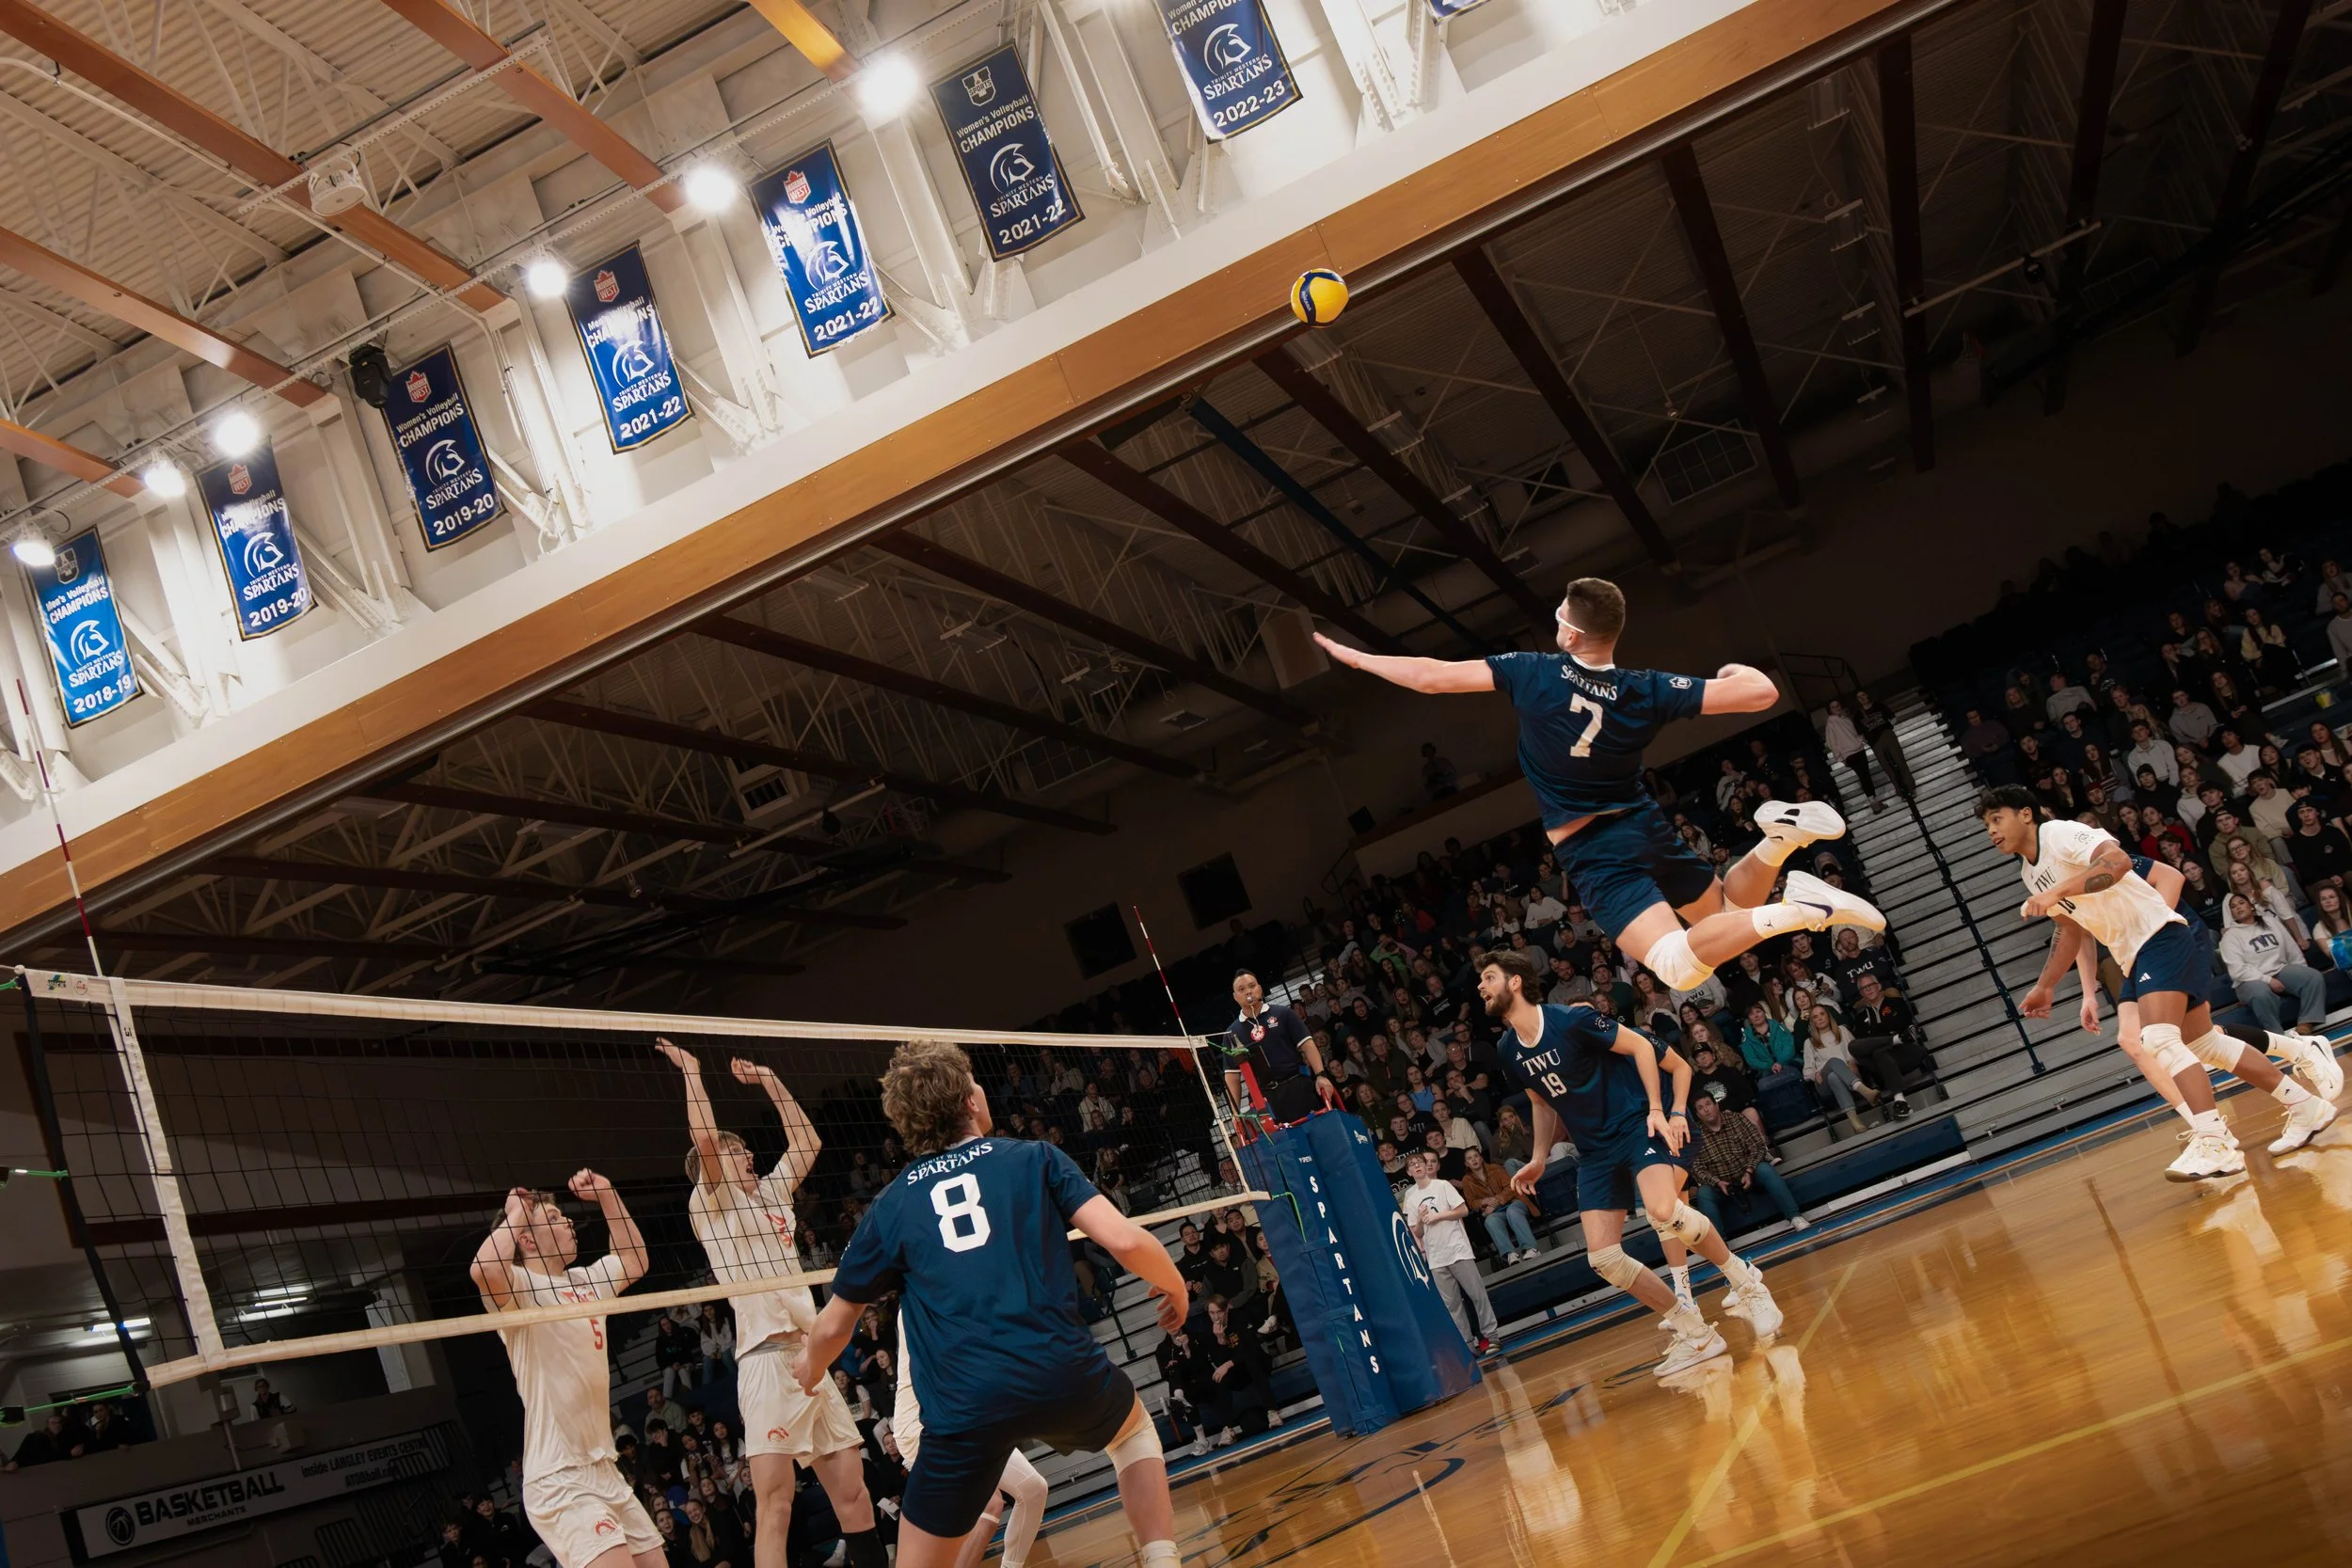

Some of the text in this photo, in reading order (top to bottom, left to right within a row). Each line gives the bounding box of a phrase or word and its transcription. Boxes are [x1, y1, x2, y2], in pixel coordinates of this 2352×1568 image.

[968, 78, 993, 97] SPORTS
[1203, 53, 1273, 101] SPARTANS
[1212, 56, 1261, 85] TRINITY WESTERN
[957, 94, 1029, 138] Women's Volleyball
[1213, 80, 1286, 128] 2022-23
[961, 105, 1034, 153] CHAMPIONS
[789, 184, 809, 201] WEST
[990, 173, 1055, 218] SPARTANS
[999, 198, 1067, 245] 2021-22
[599, 285, 618, 300] WEST
[804, 271, 870, 314] SPARTANS
[811, 284, 831, 298] TRINITY
[814, 295, 881, 341] 2021-22
[411, 387, 430, 401] WEST
[612, 370, 672, 413] SPARTANS
[396, 392, 459, 434] Women's Volleyball
[399, 403, 464, 449] CHAMPIONS
[619, 396, 682, 439] 2021-22
[426, 467, 484, 510] SPARTANS
[433, 493, 495, 536] 2019-20
[46, 576, 104, 611] Men's Volleyball
[243, 562, 300, 602] SPARTANS
[50, 587, 109, 626] CHAMPIONS
[249, 586, 308, 627] 2019-20
[69, 650, 124, 689] SPARTANS
[73, 674, 132, 714] 2018-19
[1569, 692, 1603, 758] 7
[2034, 866, 2057, 893] TWU
[2249, 933, 2280, 952] TWU
[1847, 961, 1874, 978] TWU
[1522, 1048, 1561, 1076] TWU
[1541, 1072, 1567, 1098] 19
[907, 1142, 993, 1186] SPARTANS
[930, 1172, 991, 1253] 8
[1309, 1175, 1380, 1375] SPARTANS
[590, 1318, 603, 1351] 5
[300, 1461, 329, 1478] inside
[329, 1450, 365, 1472] LANGLEY
[368, 1444, 398, 1463] EVENTS
[135, 1471, 286, 1527] BASKETBALL
[187, 1505, 247, 1527] MERCHANTS
